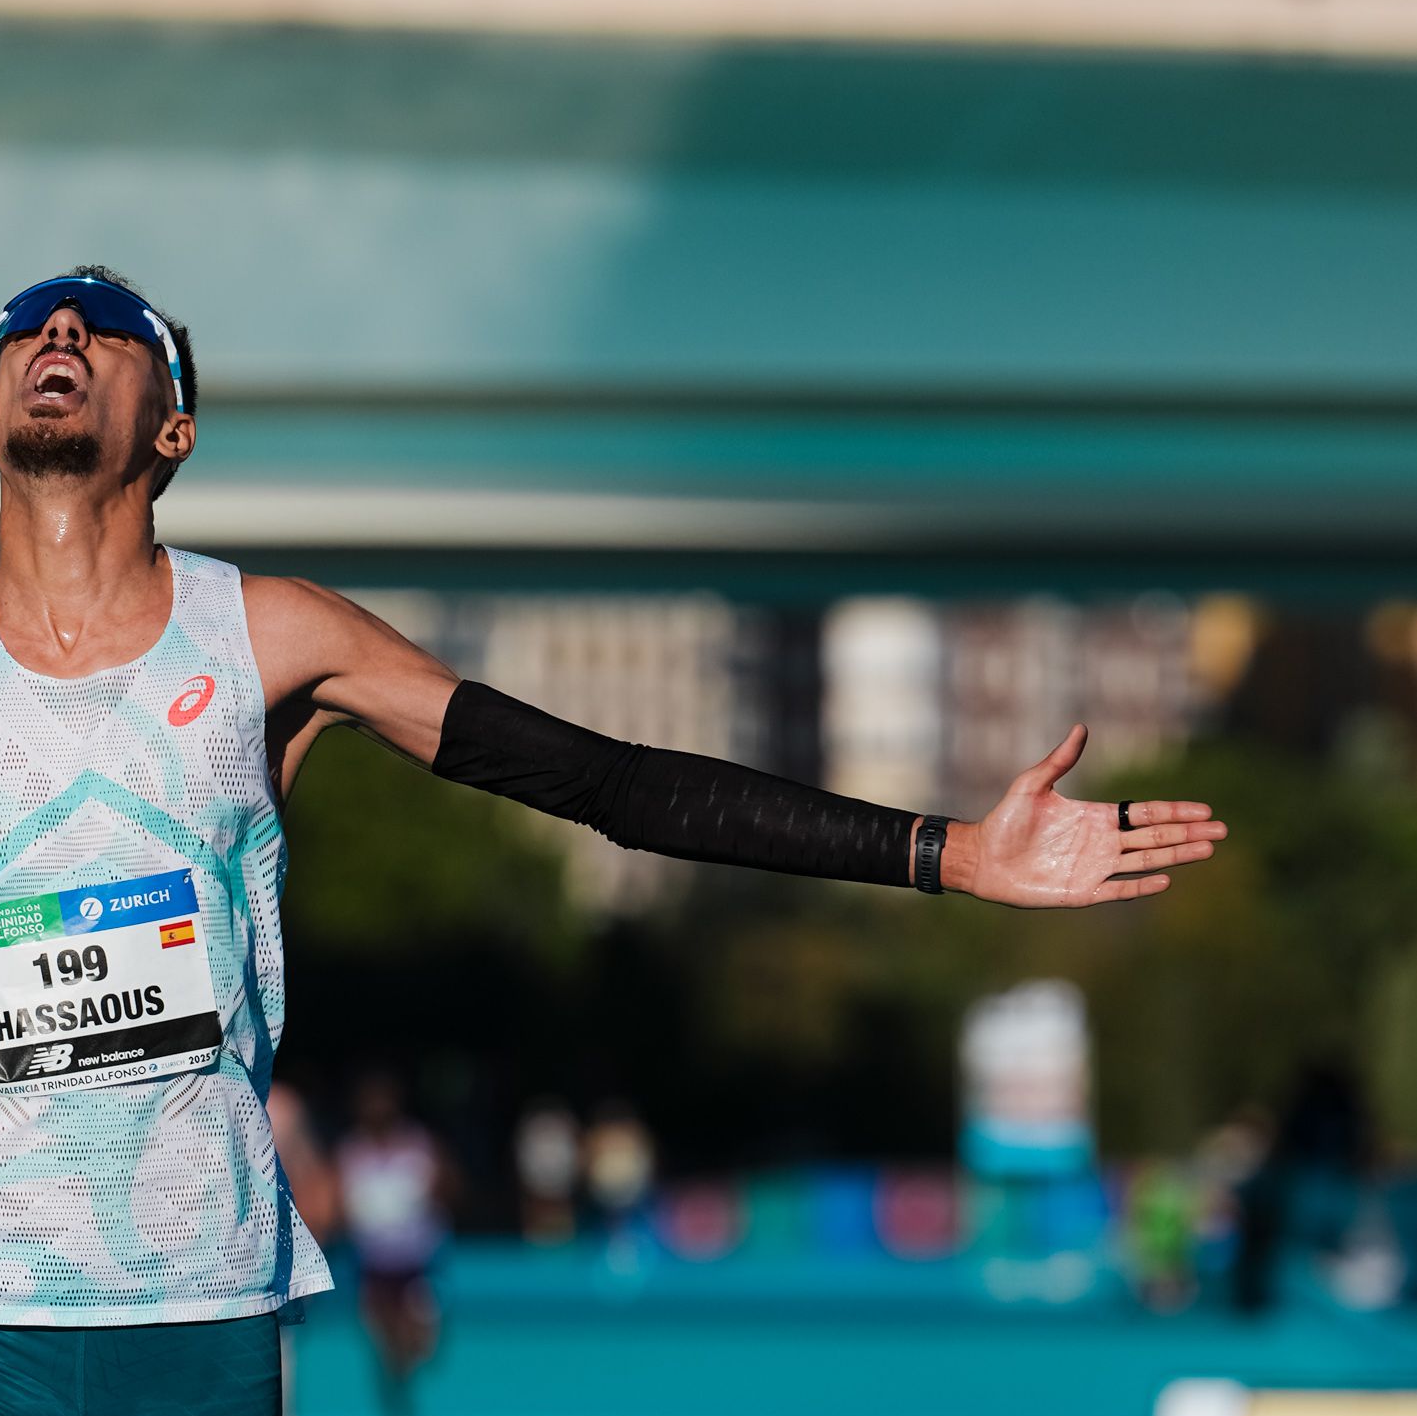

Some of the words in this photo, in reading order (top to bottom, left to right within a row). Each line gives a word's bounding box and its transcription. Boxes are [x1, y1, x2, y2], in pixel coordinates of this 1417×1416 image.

[109, 889, 170, 912] ZURICH
[32, 945, 109, 990] 199
[26, 1043, 74, 1076] NB
[78, 1055, 100, 1068] new
[101, 1048, 145, 1063] balance
[42, 1074, 93, 1091] TRINIDAD
[94, 1066, 147, 1084] ALFONSO
[188, 1053, 211, 1065] 2025
